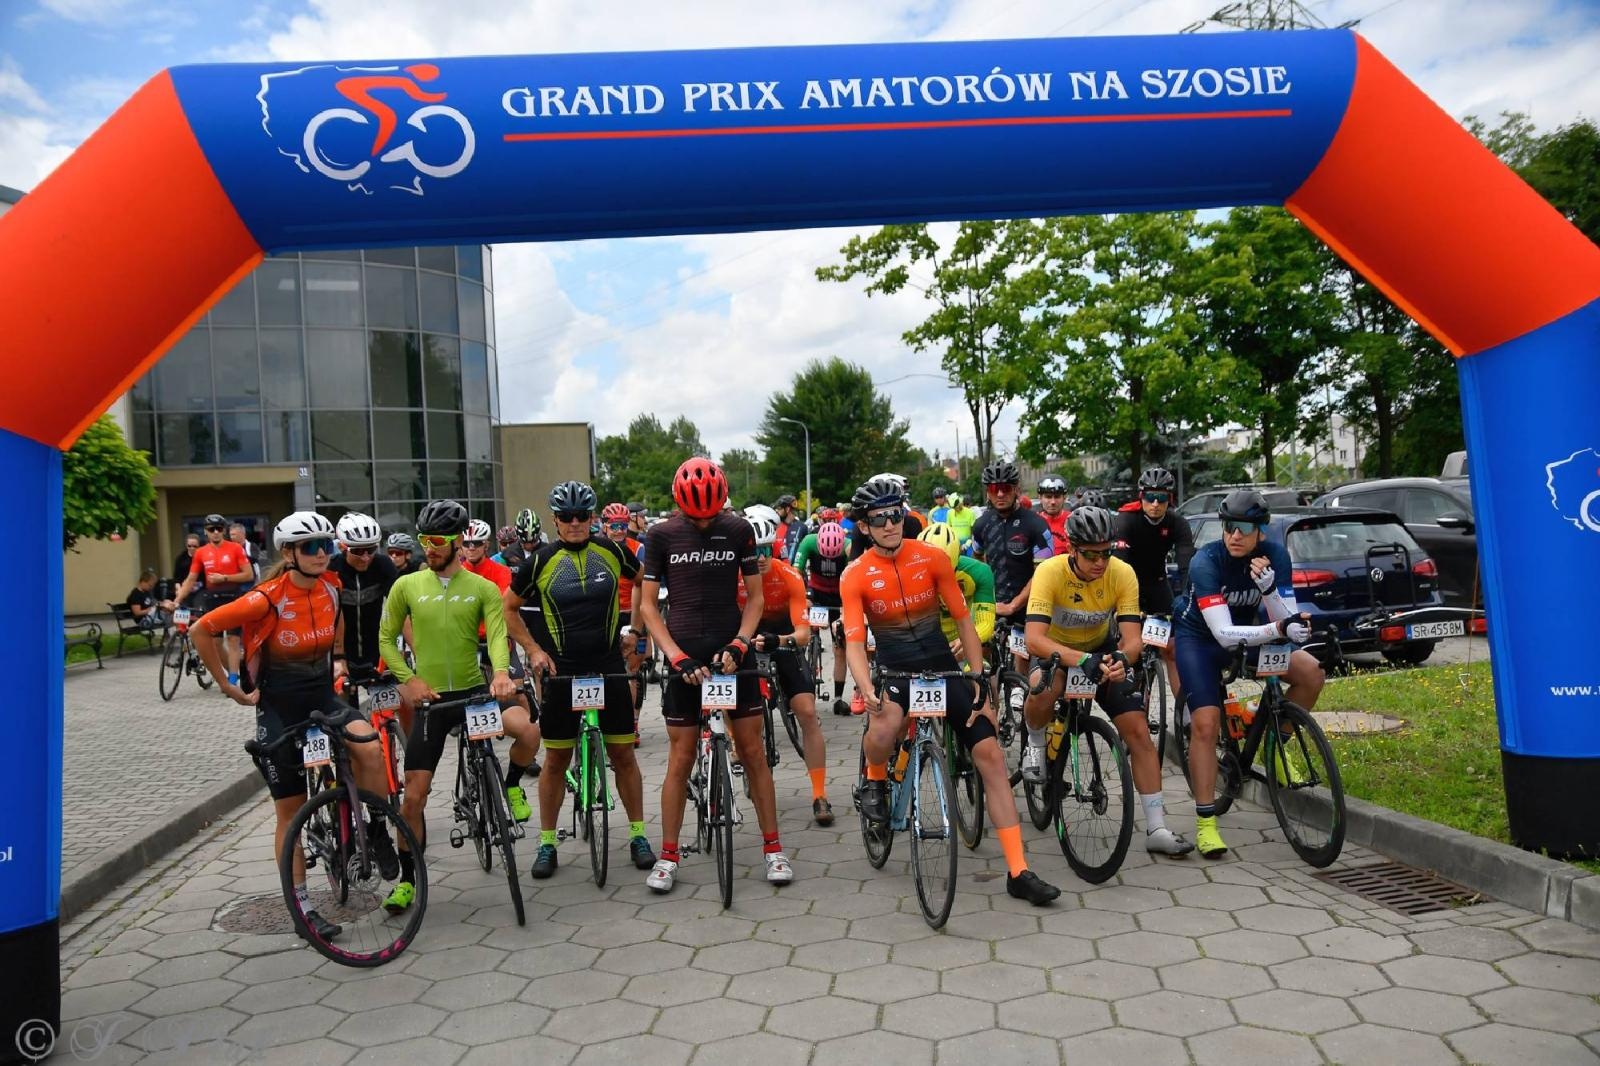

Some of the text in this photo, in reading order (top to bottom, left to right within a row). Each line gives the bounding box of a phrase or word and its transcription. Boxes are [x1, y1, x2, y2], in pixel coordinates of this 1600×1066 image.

[501, 66, 1292, 118] GRAND PRIX AMATORÓW NA SZOSIE
[1147, 625, 1167, 637] 113
[1263, 654, 1287, 665] 191
[577, 687, 600, 699] 217
[707, 684, 733, 697] 215
[915, 690, 942, 703] 218
[471, 711, 497, 727] 133
[307, 738, 326, 753] 188
